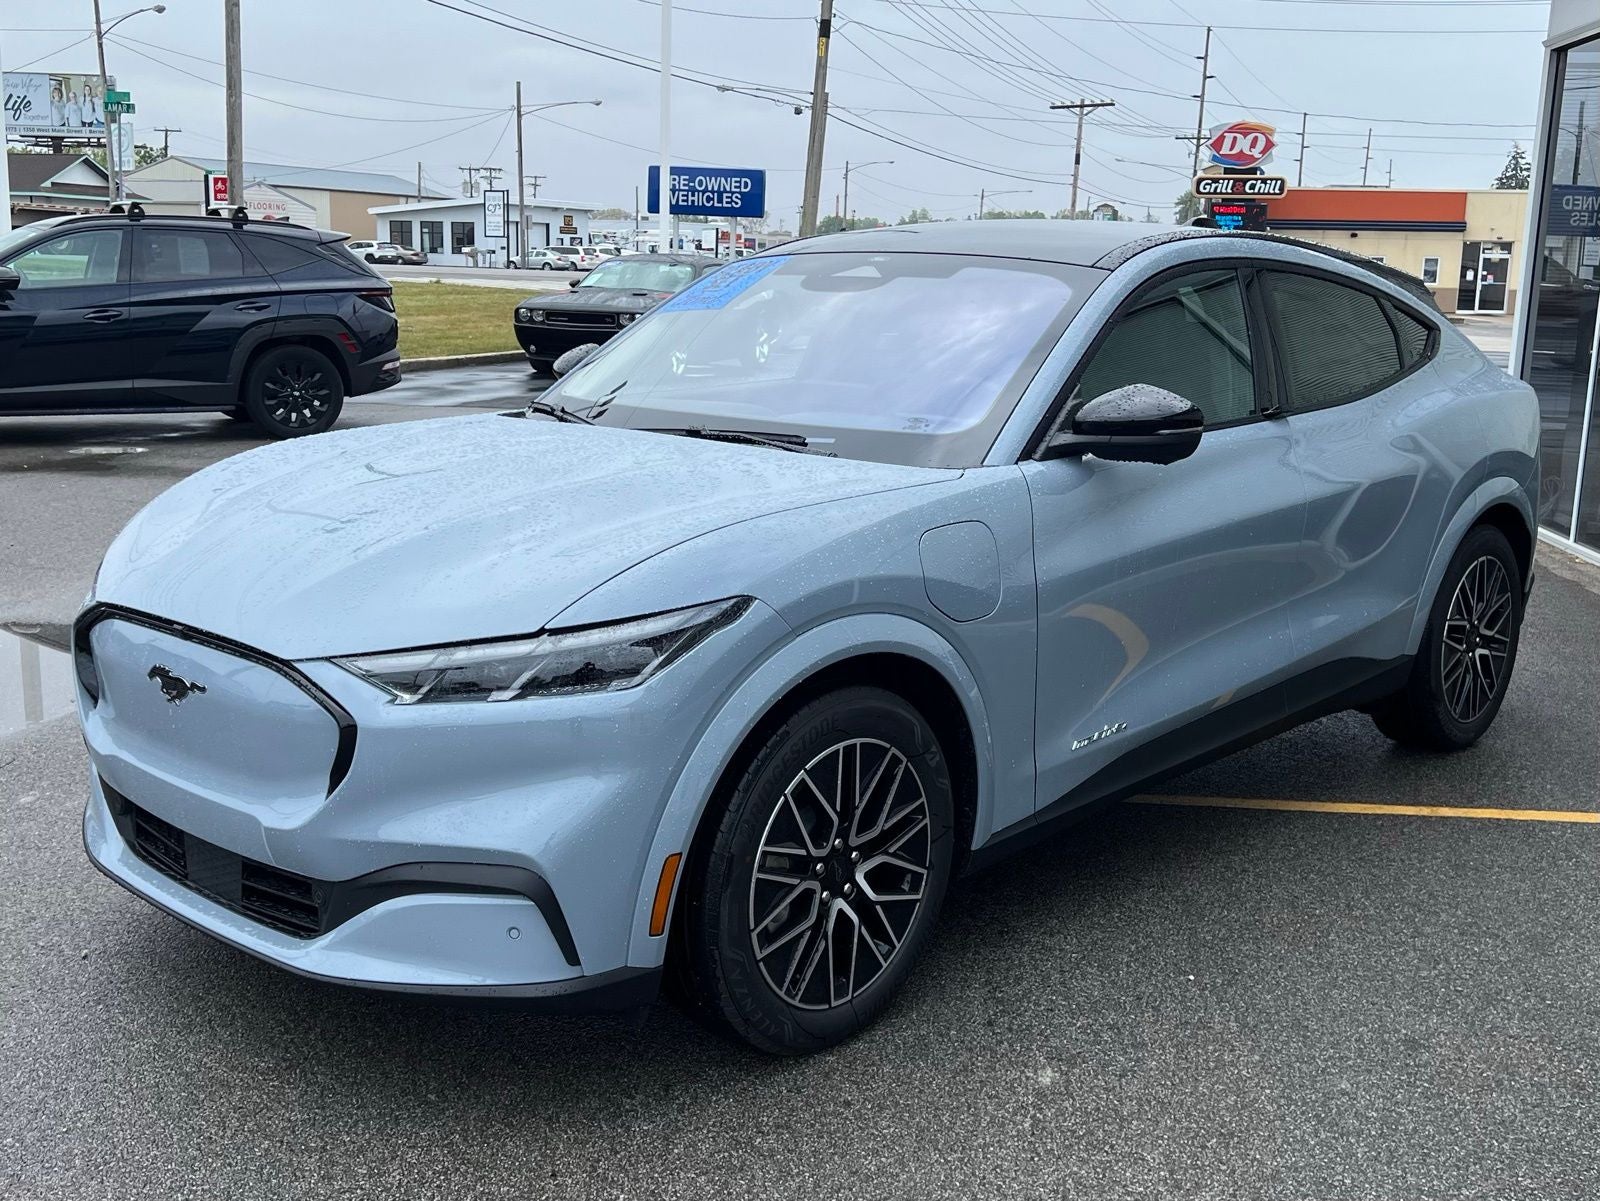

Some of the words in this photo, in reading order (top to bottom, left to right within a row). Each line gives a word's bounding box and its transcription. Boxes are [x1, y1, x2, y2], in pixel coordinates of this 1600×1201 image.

[4, 93, 32, 121] Life
[103, 102, 127, 113] LAMAR
[1219, 132, 1266, 158] DQ
[669, 175, 752, 192] RE-OWNED
[1200, 180, 1234, 194] Grill
[1234, 182, 1245, 193] &
[1245, 180, 1282, 194] Chill
[249, 202, 286, 211] FLOORING
[669, 191, 742, 208] VEHICLES
